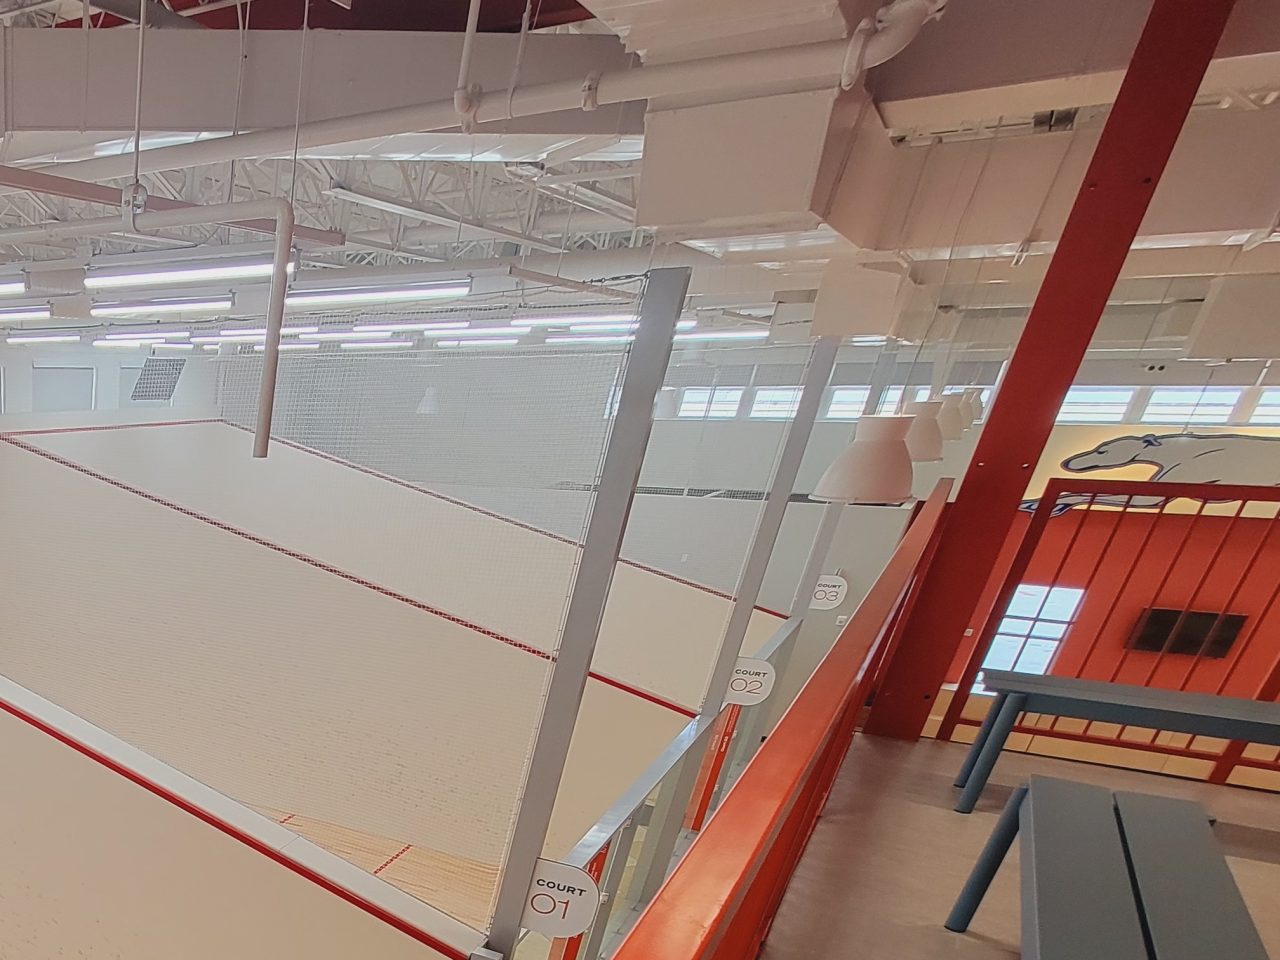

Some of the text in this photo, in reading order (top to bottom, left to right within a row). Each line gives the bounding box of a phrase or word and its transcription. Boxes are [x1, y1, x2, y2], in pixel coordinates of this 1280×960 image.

[814, 589, 838, 601] 03
[735, 668, 768, 678] COURT
[730, 677, 763, 695] 02
[536, 878, 587, 897] COURT
[530, 893, 570, 920] 01
